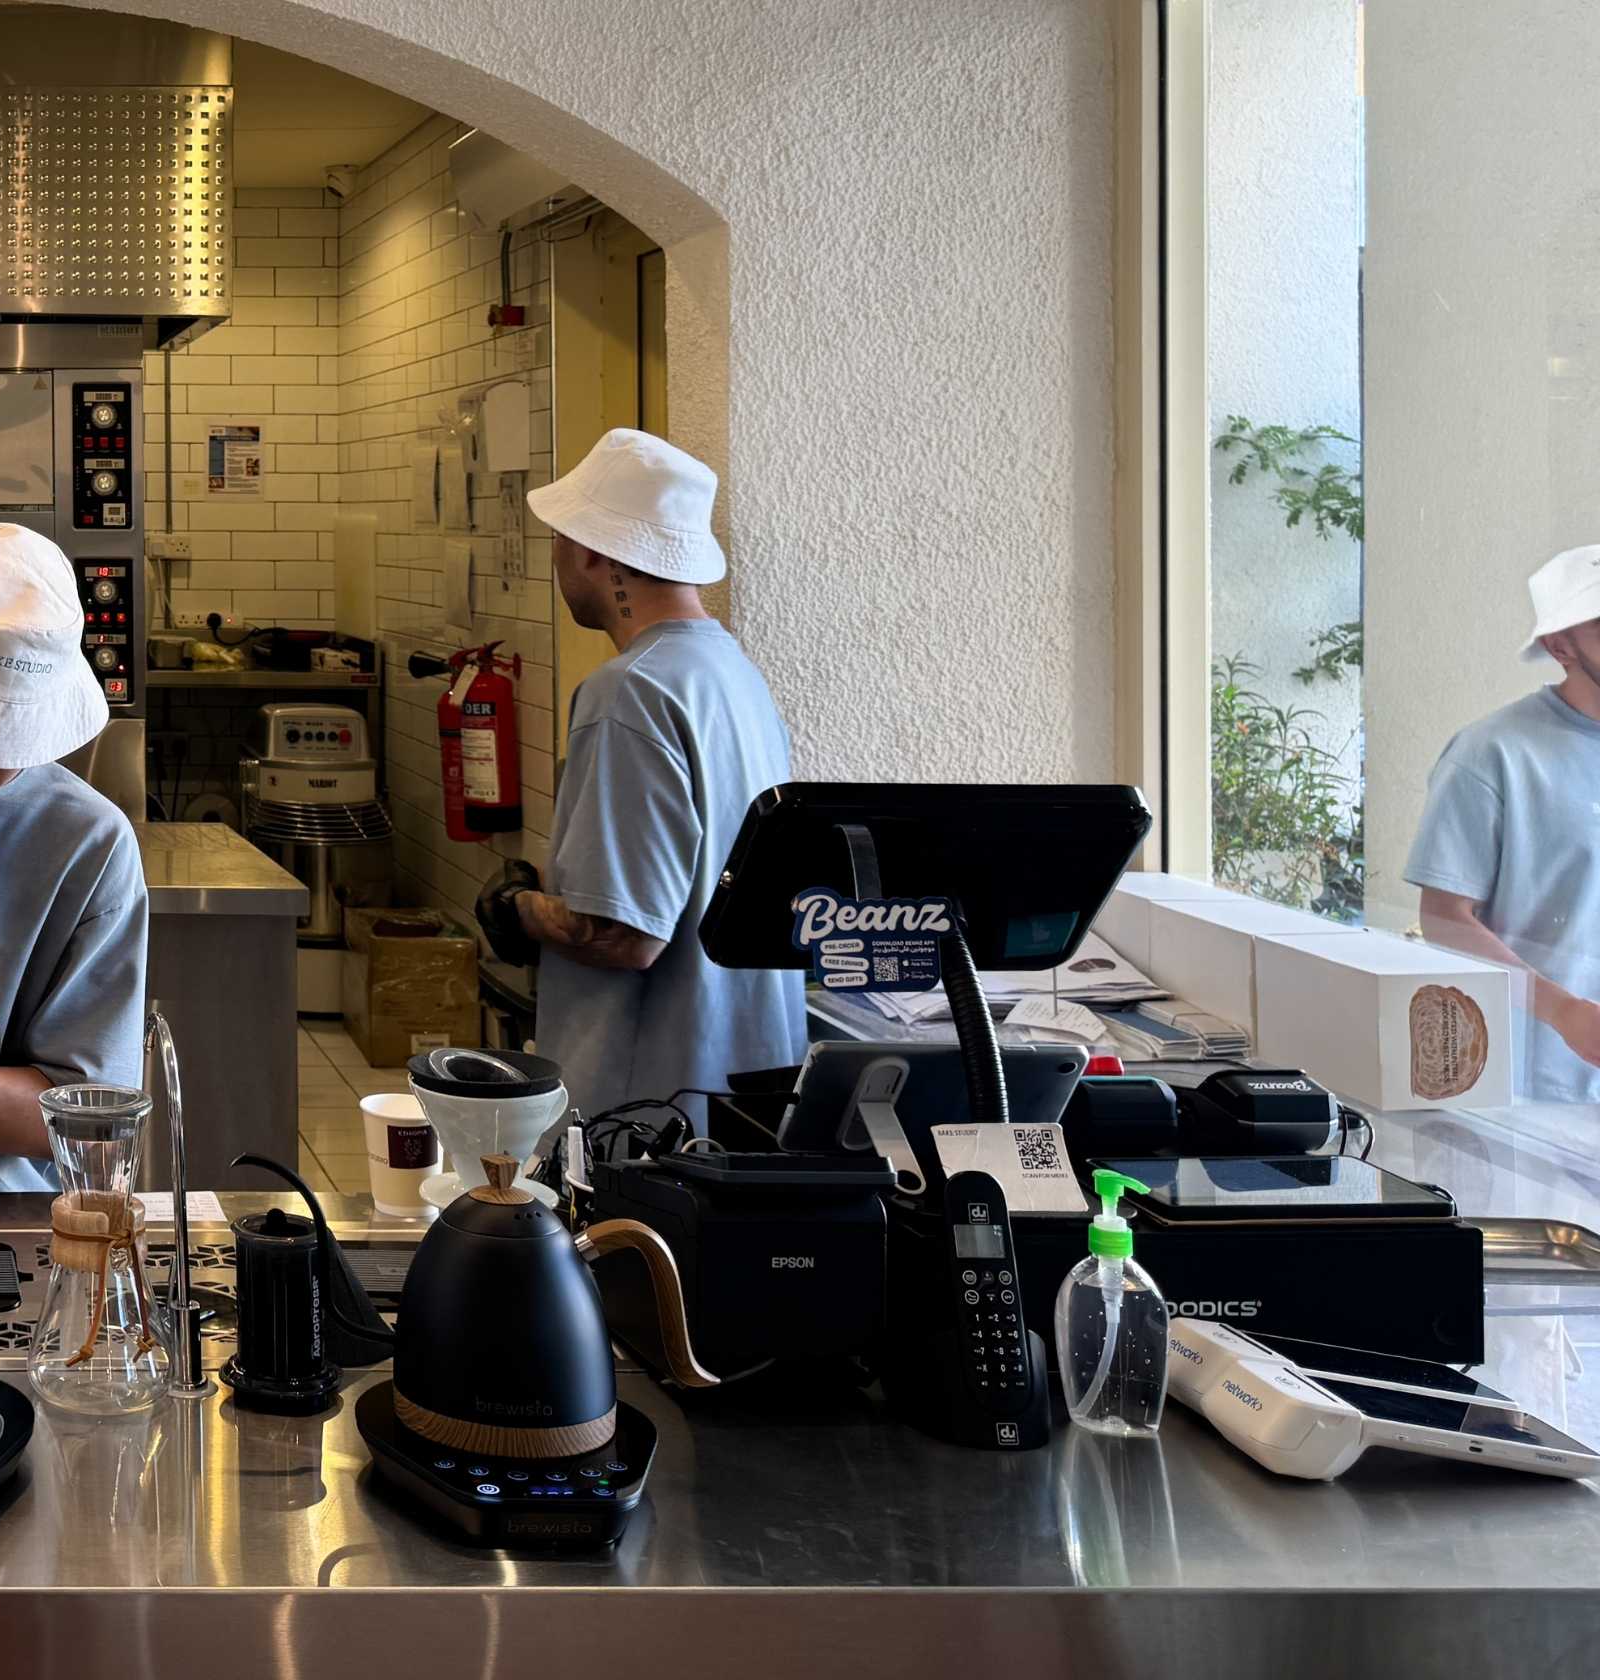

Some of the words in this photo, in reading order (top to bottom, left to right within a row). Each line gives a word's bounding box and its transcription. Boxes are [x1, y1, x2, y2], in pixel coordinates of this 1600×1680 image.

[14, 660, 53, 674] STUDIO
[798, 894, 951, 945] Beanz
[771, 1256, 815, 1268] EPSON
[1166, 1301, 1258, 1317] OODICS
[1169, 1339, 1201, 1364] etwork
[1222, 1379, 1259, 1408] network
[475, 1397, 553, 1416] brewista
[1000, 1425, 1016, 1438] du
[507, 1520, 592, 1534] brewista
